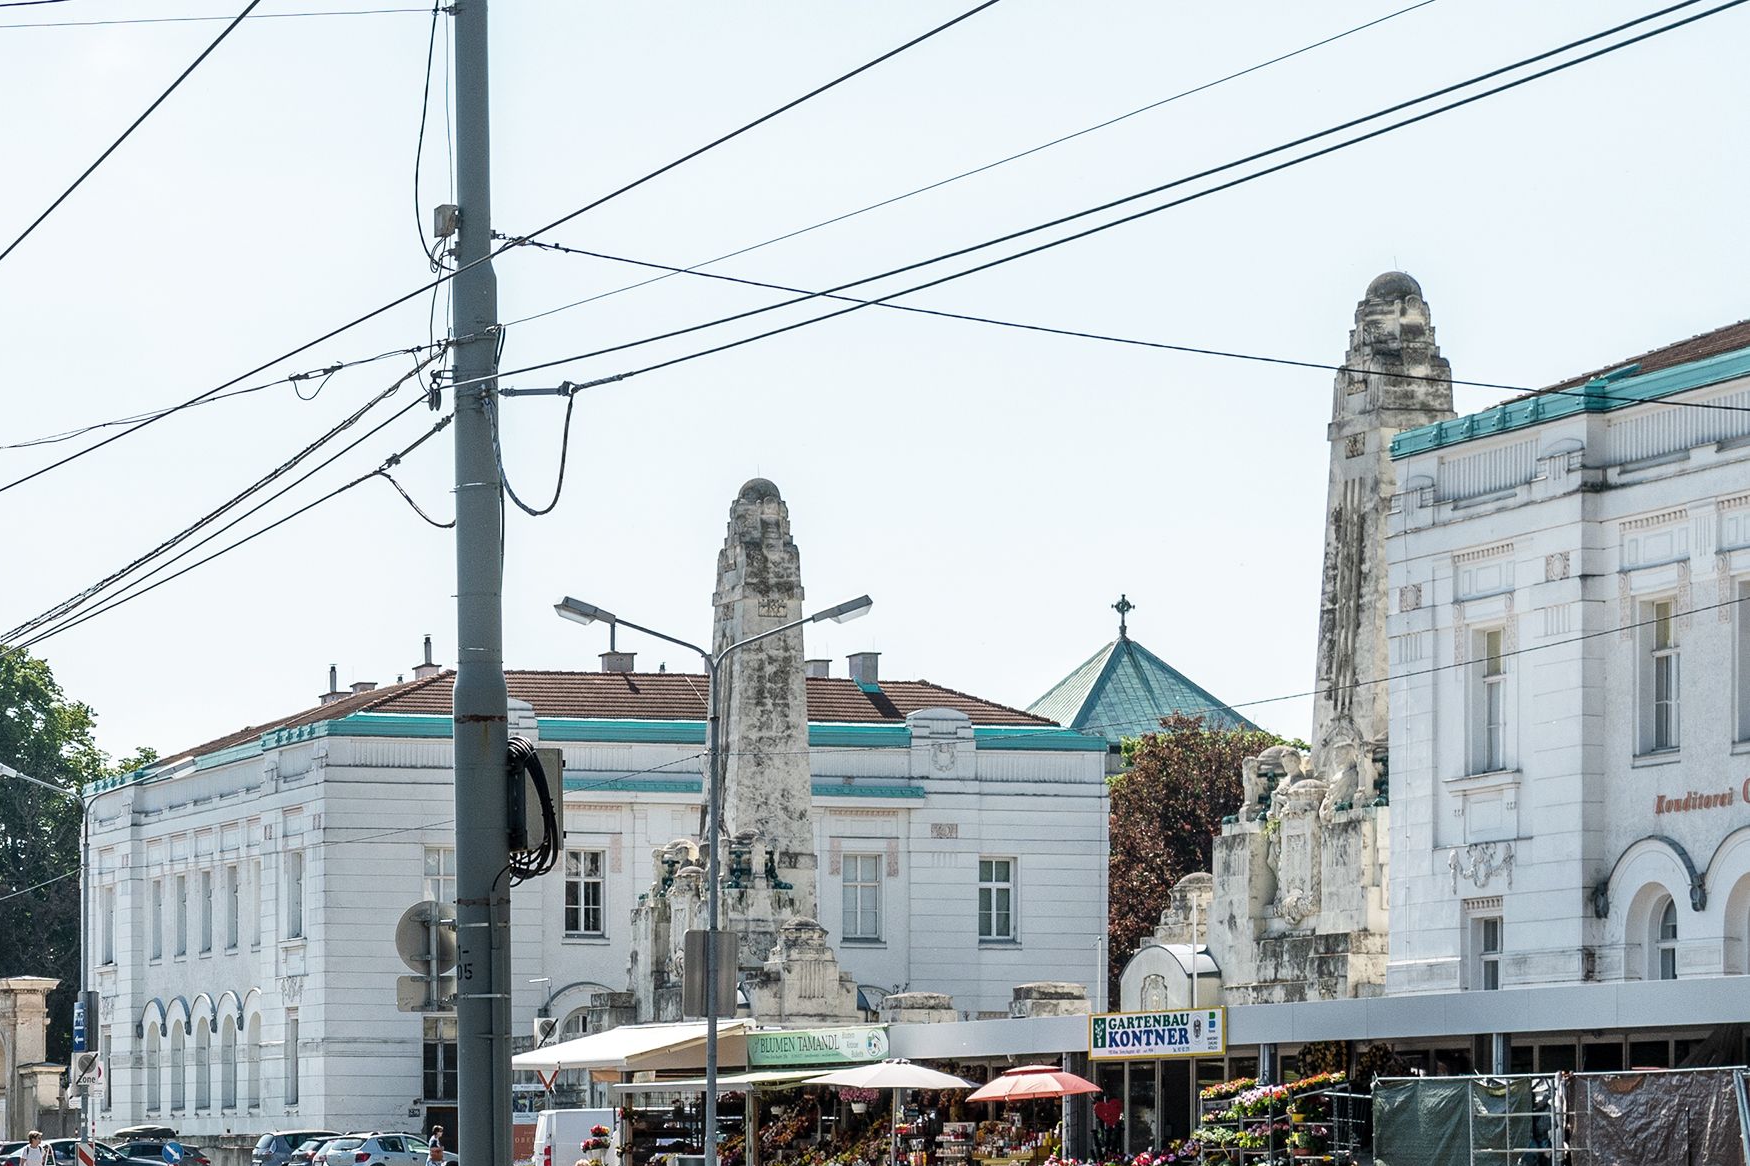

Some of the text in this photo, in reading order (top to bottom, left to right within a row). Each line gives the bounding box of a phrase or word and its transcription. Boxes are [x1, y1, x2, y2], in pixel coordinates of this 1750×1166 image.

[1108, 1013, 1190, 1031] GARTENBAU
[760, 1034, 840, 1053] BLUMEN TAMANDL
[1108, 1027, 1190, 1048] KONTNER
